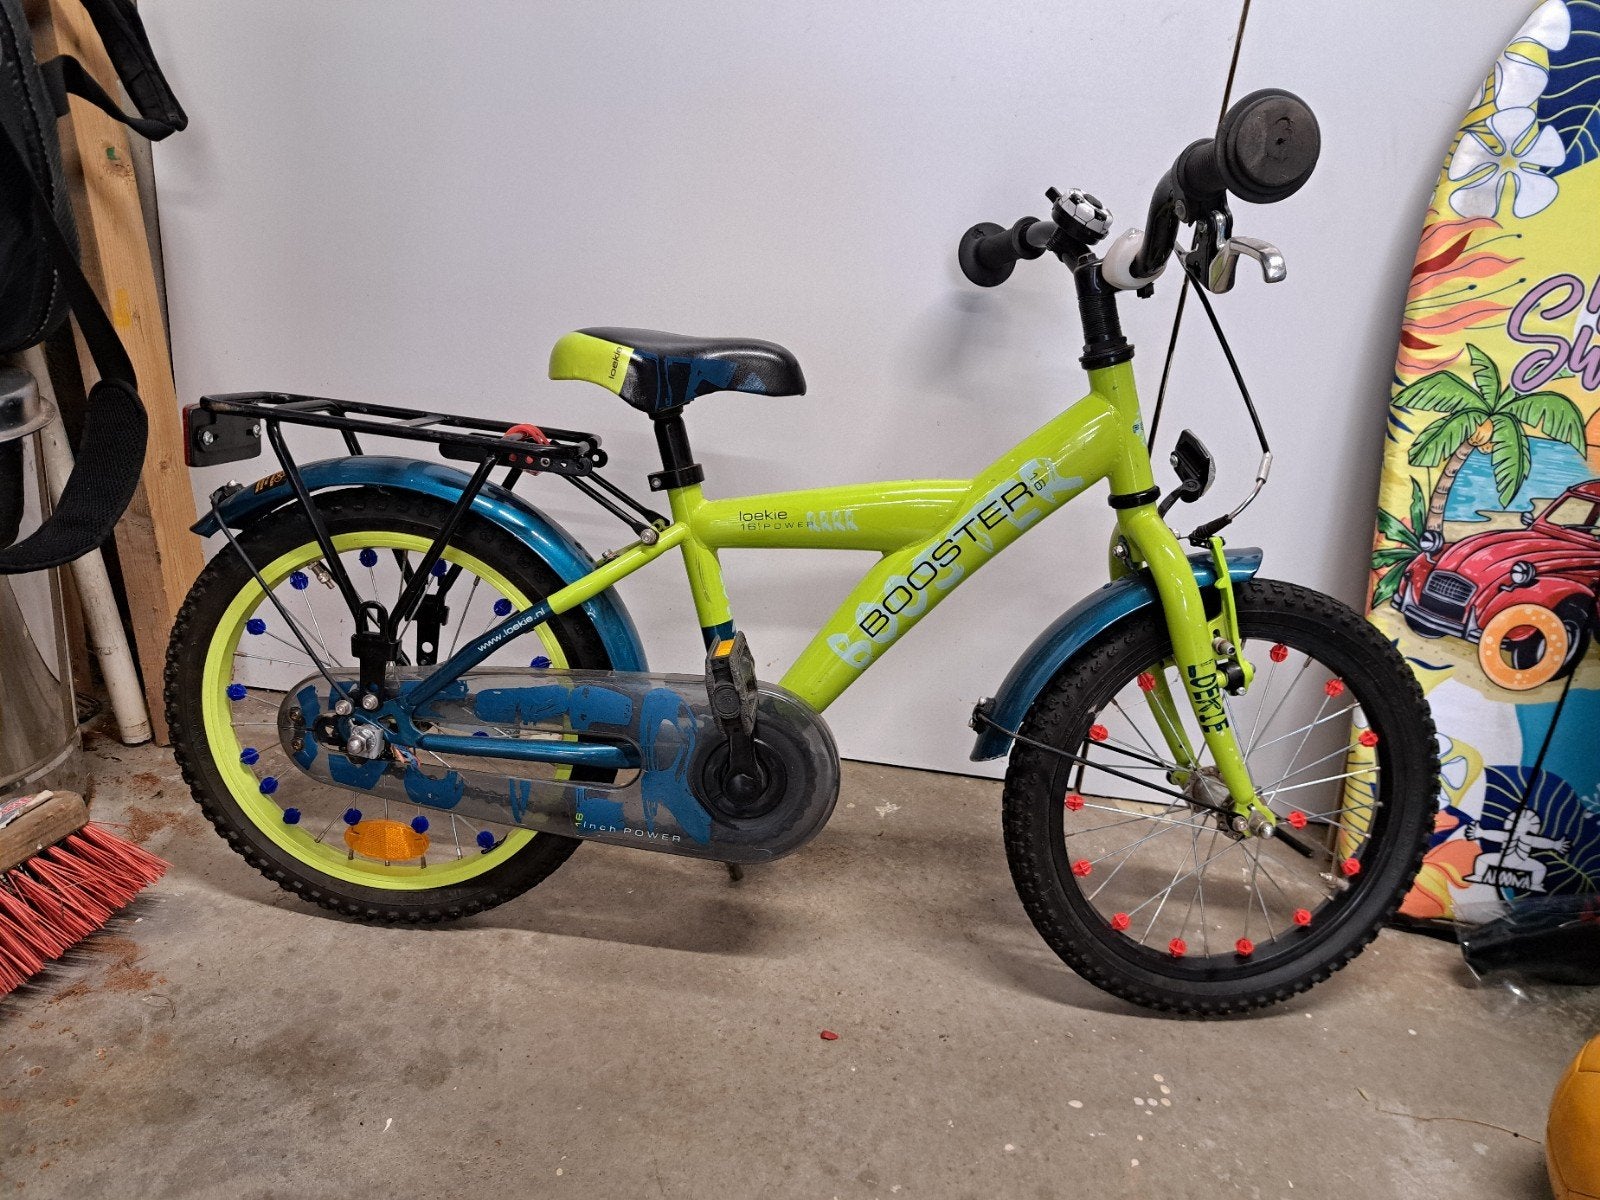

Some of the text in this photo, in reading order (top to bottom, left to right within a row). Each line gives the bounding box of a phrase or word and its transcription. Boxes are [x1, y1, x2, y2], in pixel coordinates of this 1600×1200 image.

[739, 509, 788, 522] loekie
[858, 481, 1035, 639] BOOSTER
[477, 607, 546, 652] www.loekie.nl
[623, 827, 681, 842] POWER
